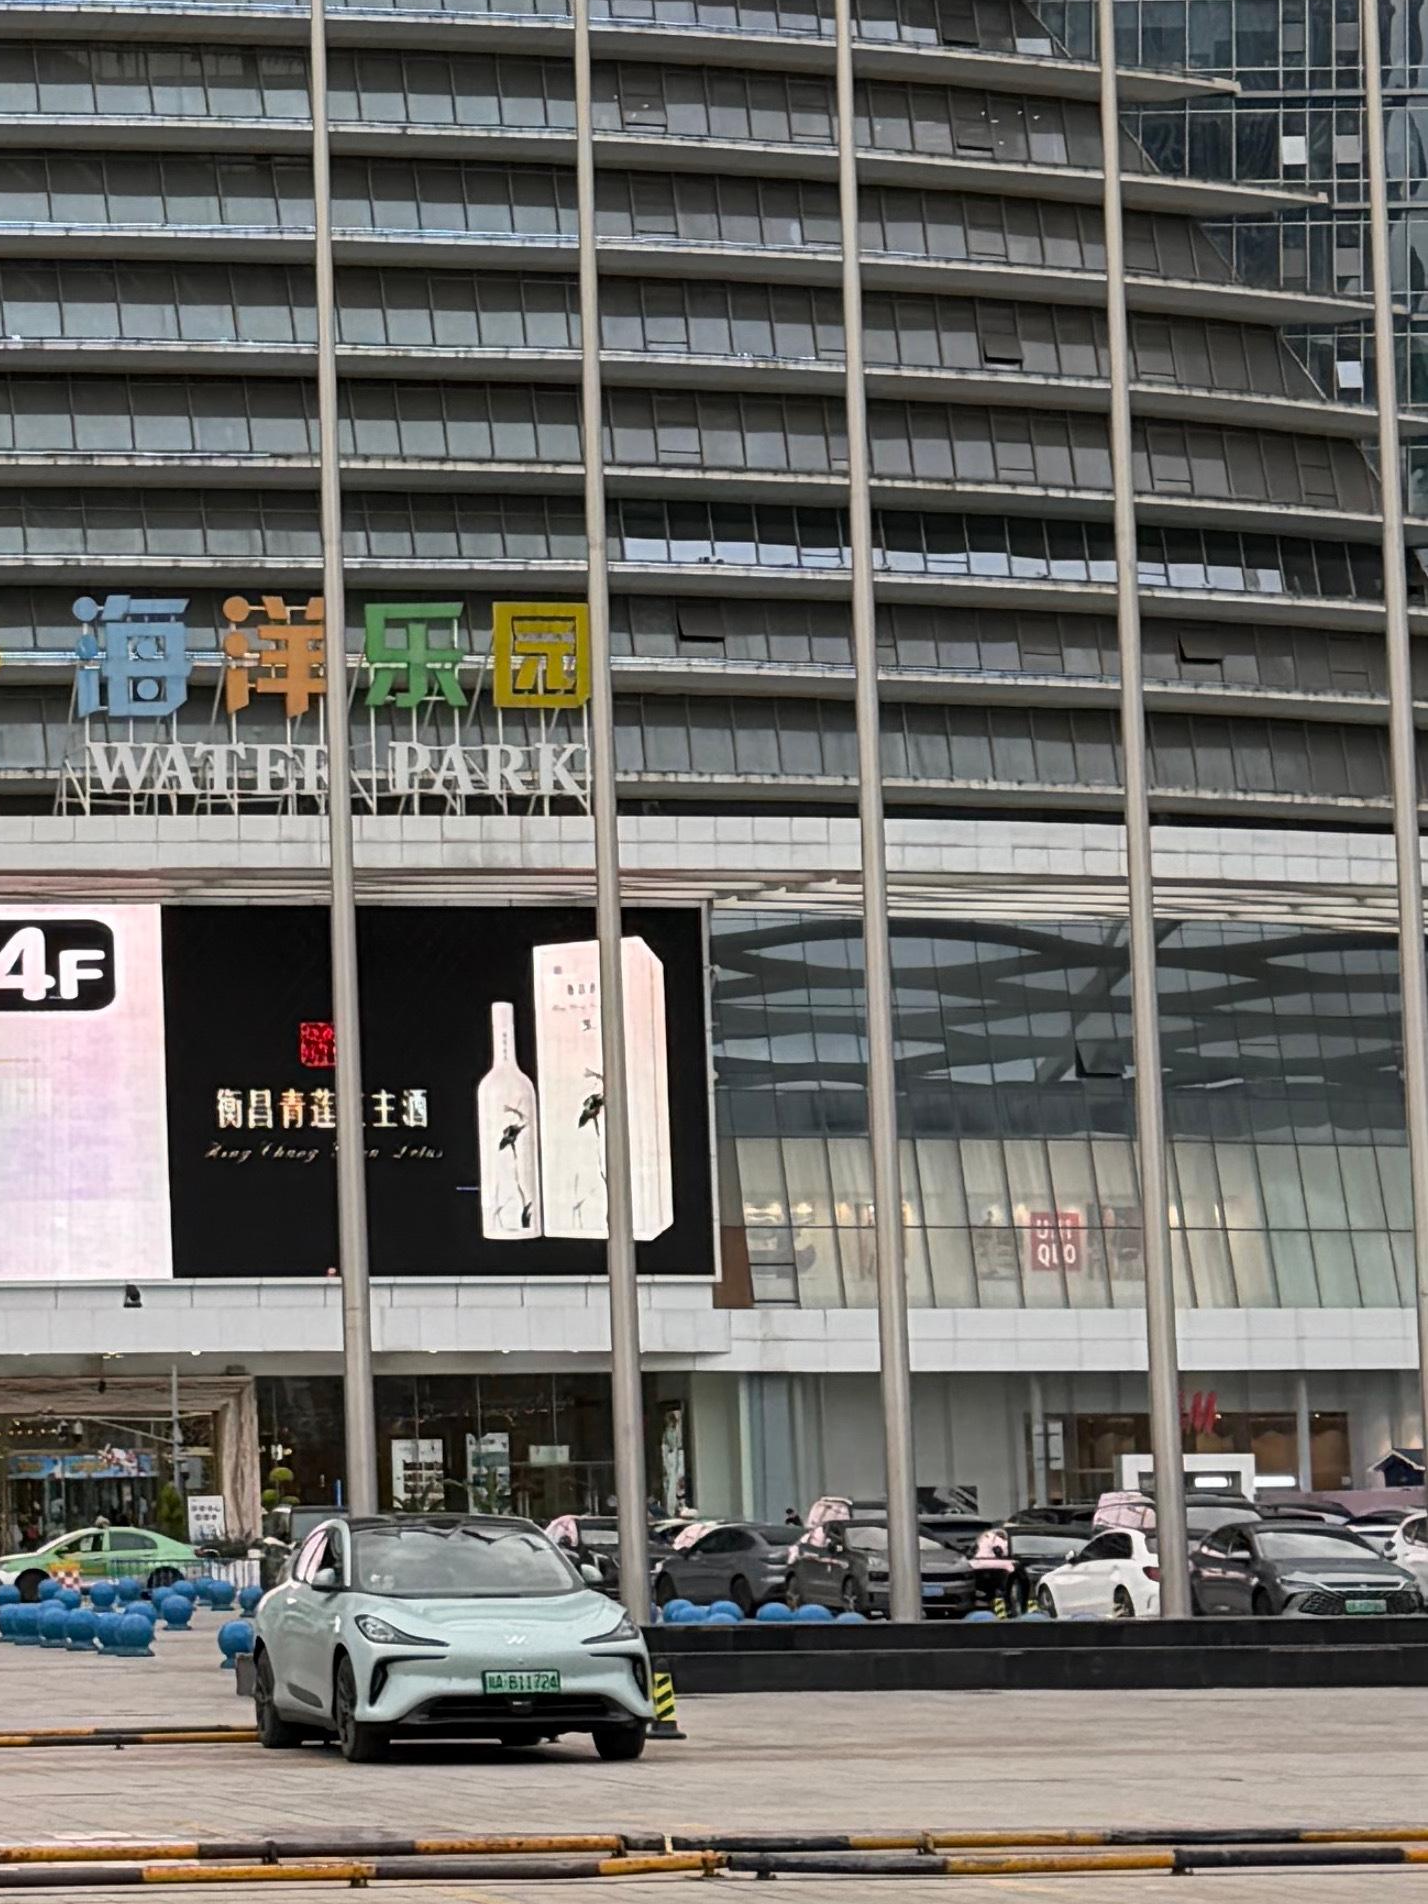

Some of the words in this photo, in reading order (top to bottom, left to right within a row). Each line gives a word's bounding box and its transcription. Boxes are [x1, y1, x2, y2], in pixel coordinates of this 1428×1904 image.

[72, 595, 589, 718] 海洋乐园
[391, 743, 588, 797] PARK
[216, 1087, 429, 1129] 衡昌青莲主酒
